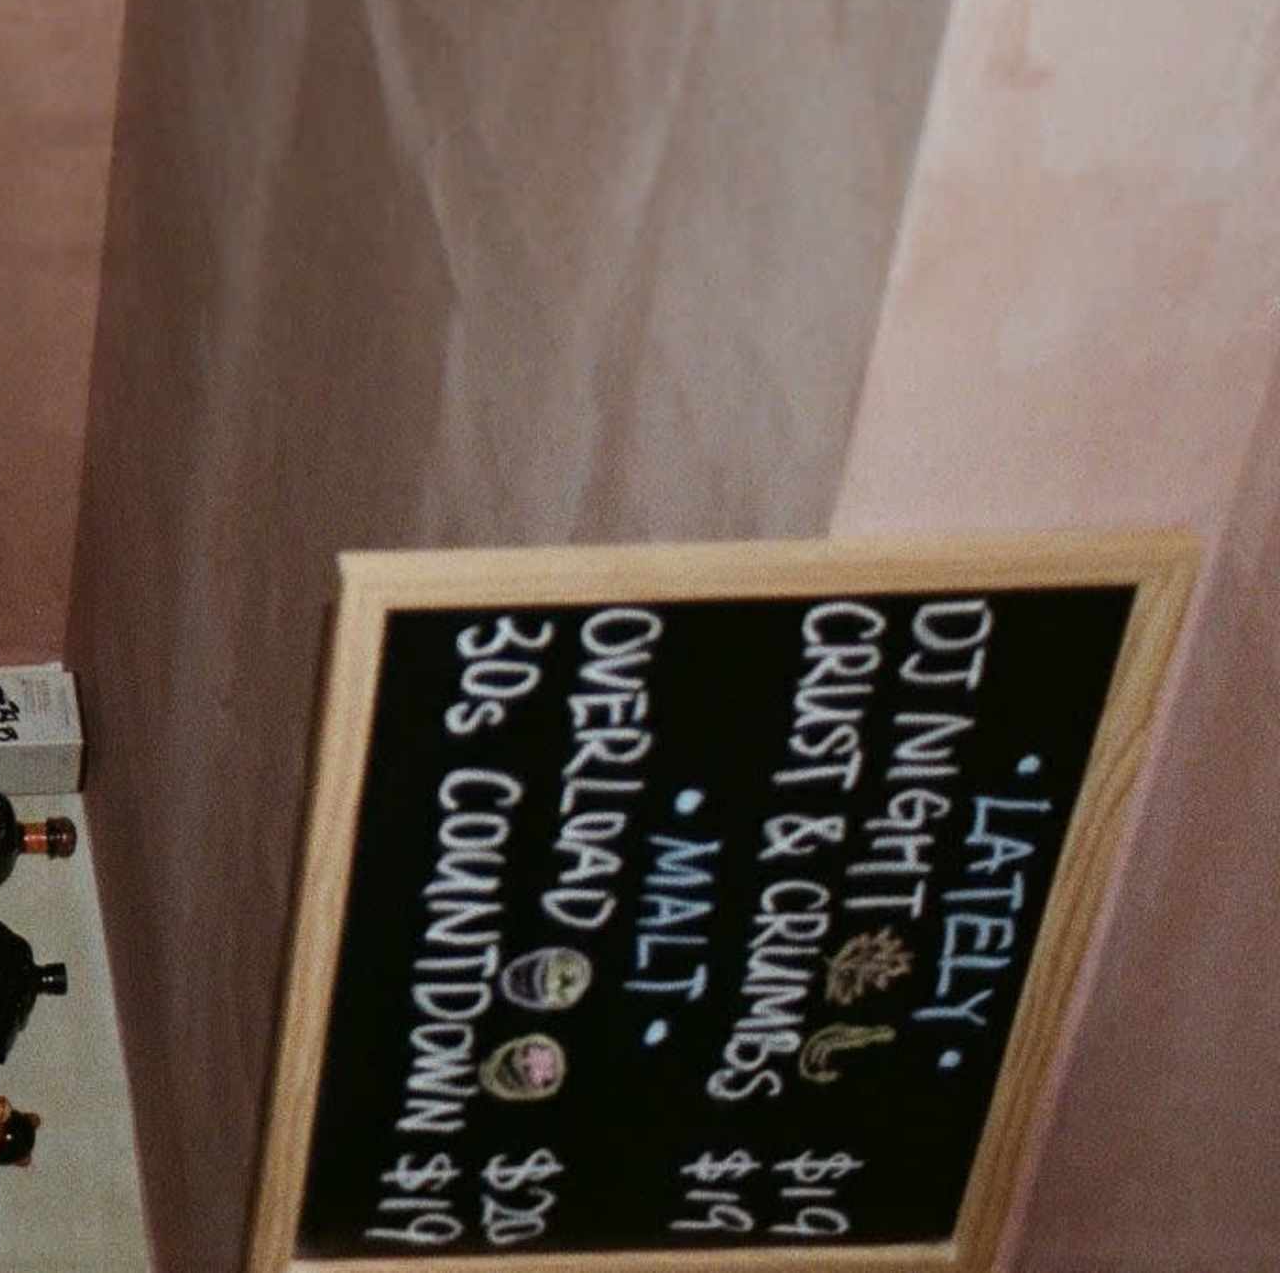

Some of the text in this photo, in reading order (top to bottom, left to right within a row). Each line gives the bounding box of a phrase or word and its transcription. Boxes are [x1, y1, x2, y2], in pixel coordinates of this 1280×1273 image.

[365, 615, 555, 1246] 30s COUNTDOWN $19
[481, 605, 664, 1246] OVERLOAD $20
[625, 834, 722, 1001] MALT
[671, 599, 887, 1232] CRUST & CRUMBS $19
[771, 598, 994, 1237] DJ NIGHT $19
[914, 795, 1052, 1025] LATELY
